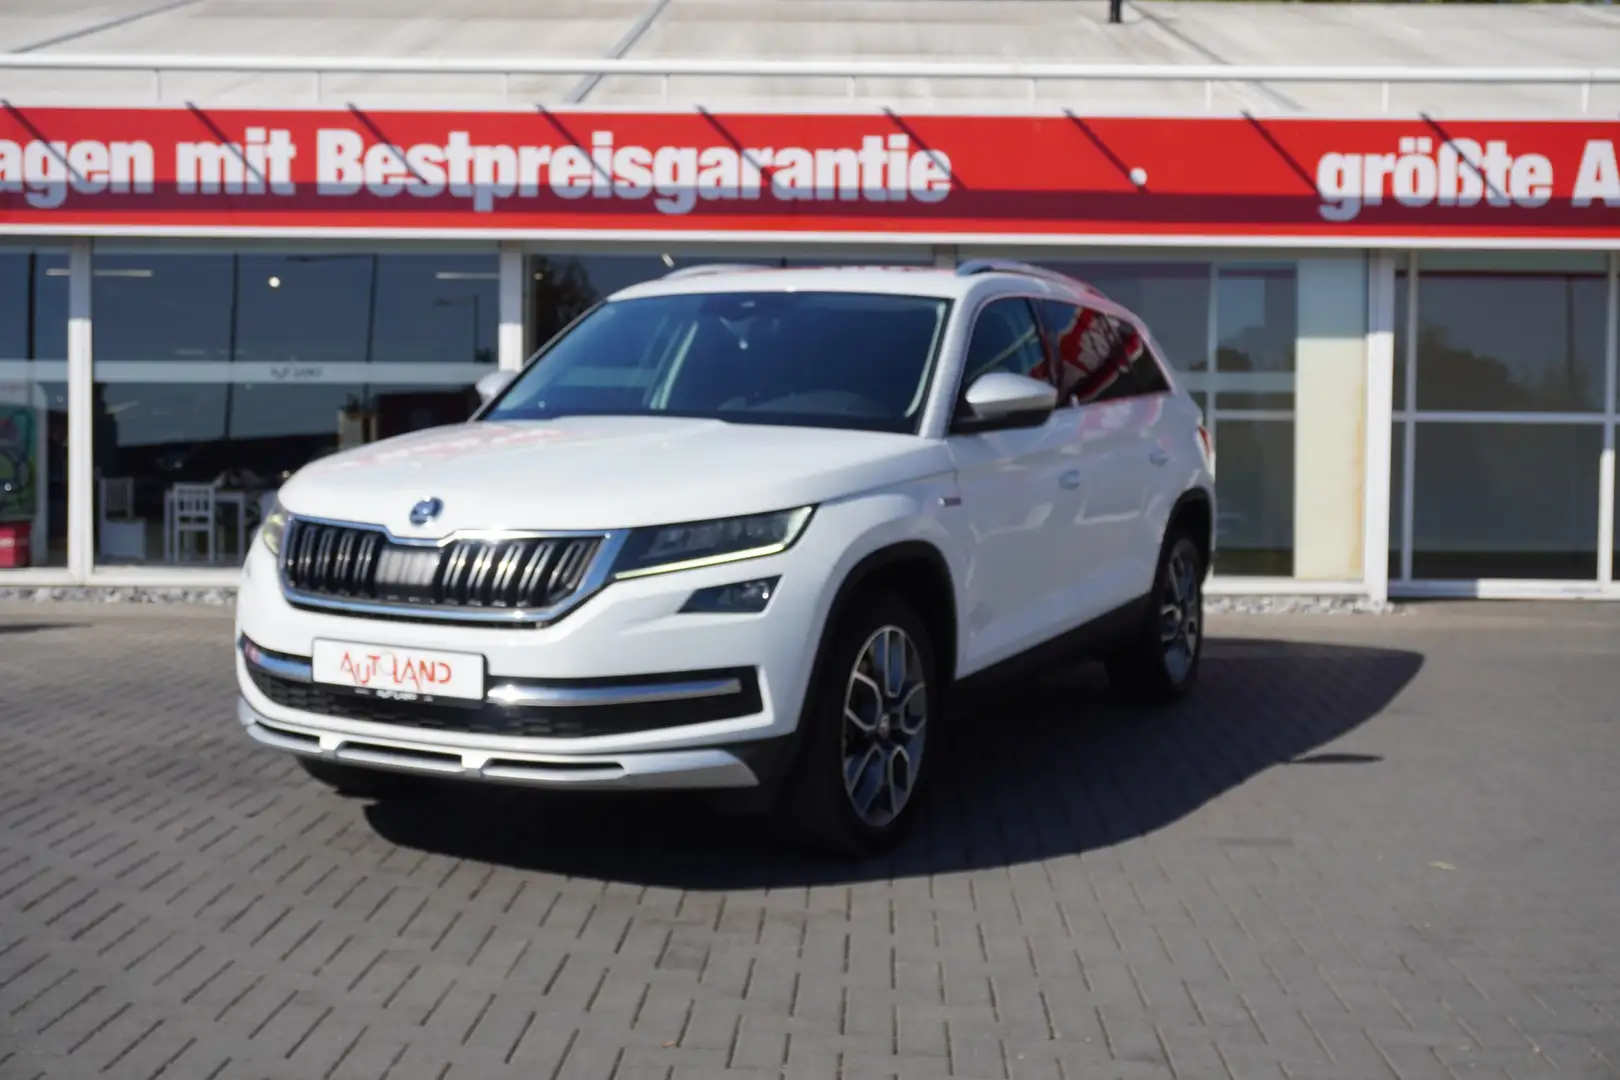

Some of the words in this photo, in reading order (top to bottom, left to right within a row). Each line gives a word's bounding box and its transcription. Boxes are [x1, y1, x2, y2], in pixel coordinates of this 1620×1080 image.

[176, 127, 297, 195] mit
[316, 129, 952, 214] Bestpreisgarantie
[1317, 137, 1554, 221] größte
[1571, 139, 1620, 208] A
